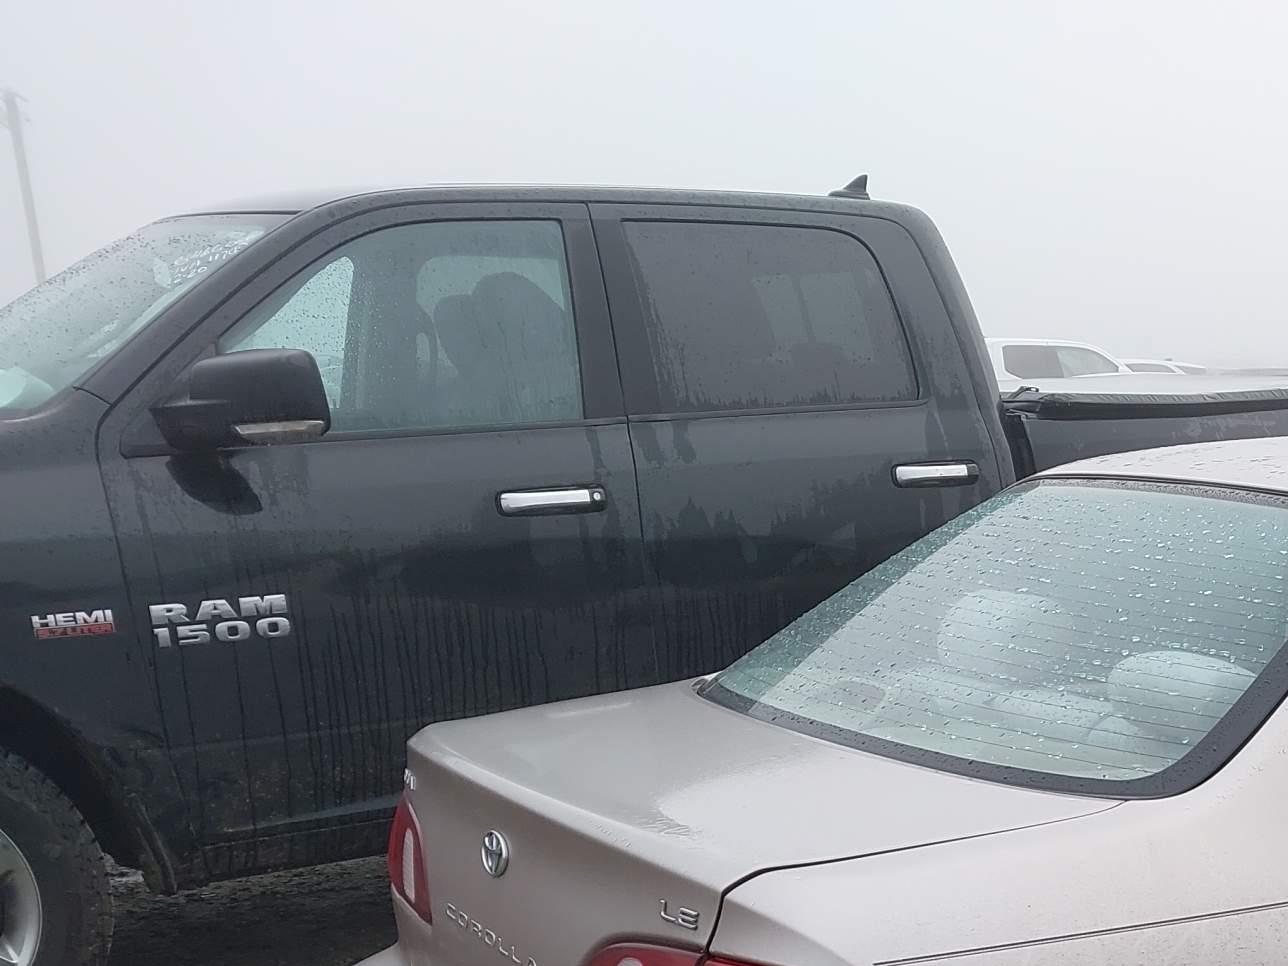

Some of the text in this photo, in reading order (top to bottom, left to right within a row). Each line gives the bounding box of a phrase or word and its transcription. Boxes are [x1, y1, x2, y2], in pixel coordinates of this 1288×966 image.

[31, 609, 113, 628] HEMI
[149, 594, 288, 625] RAM
[153, 616, 290, 648] 1500
[659, 898, 699, 930] LE
